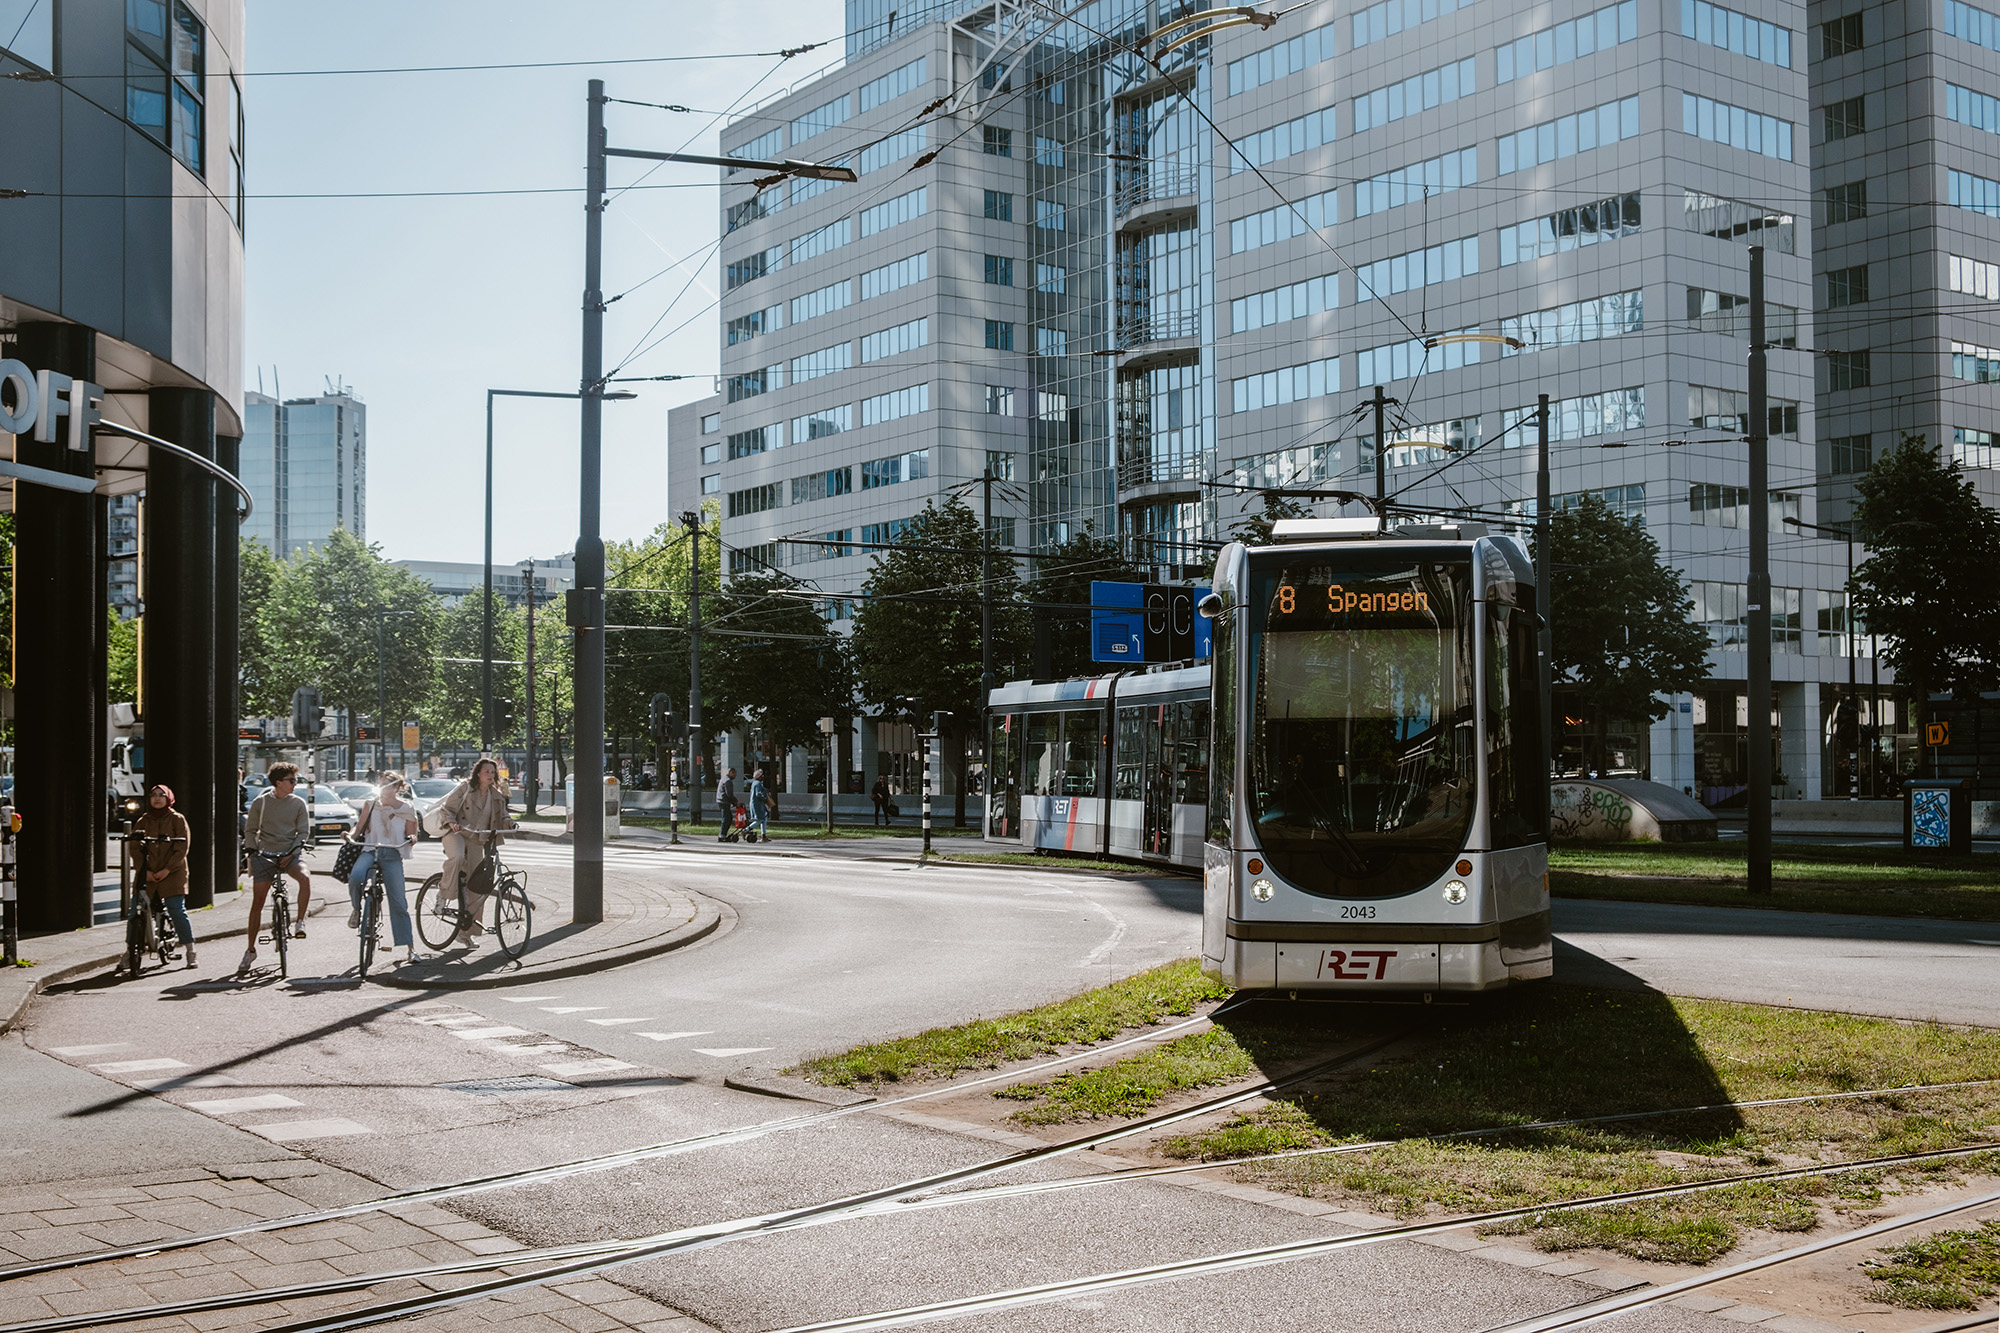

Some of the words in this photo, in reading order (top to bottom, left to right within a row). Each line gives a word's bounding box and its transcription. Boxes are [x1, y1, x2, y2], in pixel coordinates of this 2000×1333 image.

[0, 358, 104, 452] OFF
[1279, 585, 1296, 614] 8
[1328, 584, 1428, 613] Spangen
[1931, 728, 1939, 741] W
[1053, 799, 1069, 815] RET
[1340, 905, 1377, 920] 2043
[1317, 950, 1398, 980] RET
